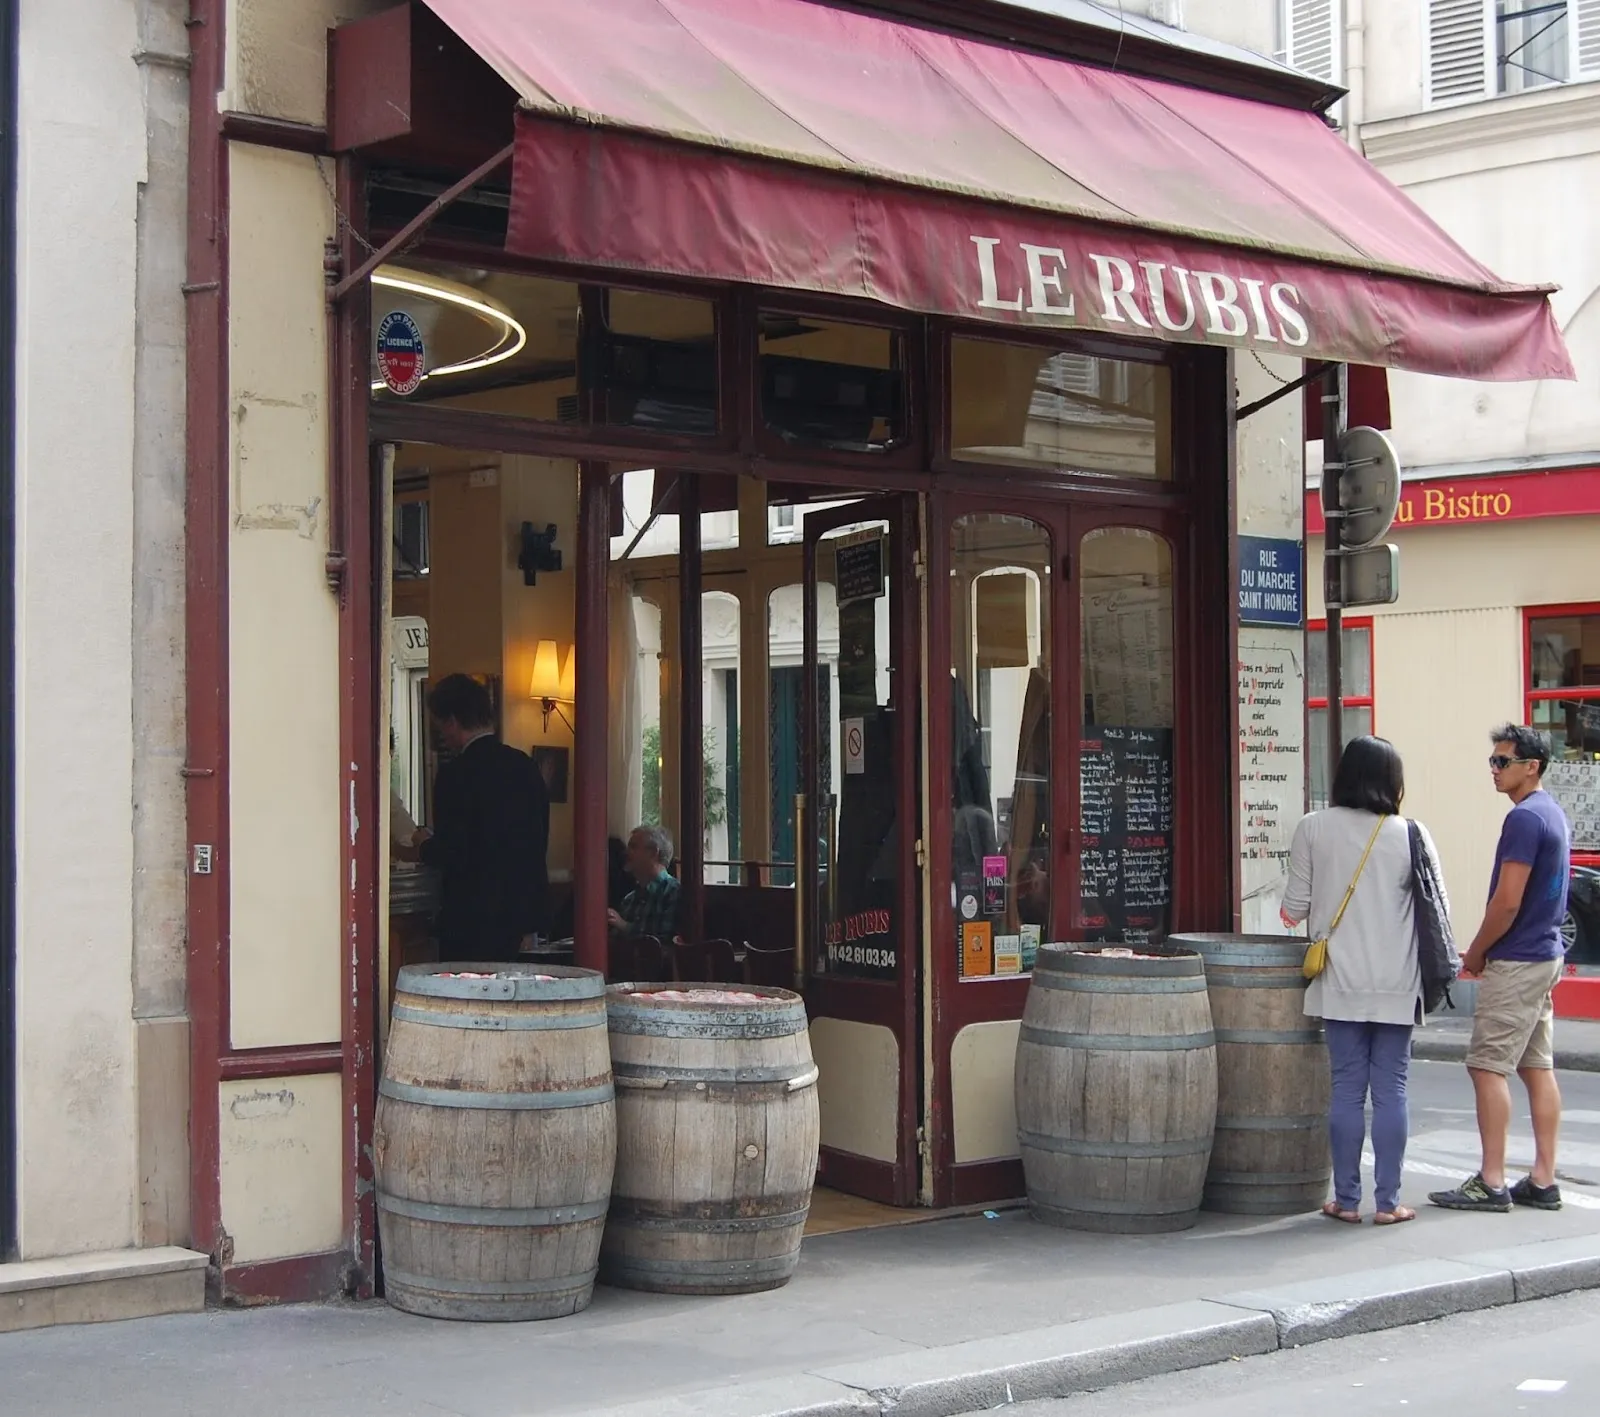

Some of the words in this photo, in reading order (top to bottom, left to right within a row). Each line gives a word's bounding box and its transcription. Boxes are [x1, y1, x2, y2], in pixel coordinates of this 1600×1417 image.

[970, 235, 1075, 316] LE
[1088, 252, 1309, 346] RUBIS
[378, 316, 394, 341] VILLE
[402, 316, 421, 343] PARIS
[386, 337, 414, 348] LICENCE
[396, 353, 424, 392] BOISSONS
[1393, 500, 1415, 522] u
[1423, 487, 1512, 520] Bistro
[1259, 549, 1278, 568] RUE
[1241, 569, 1255, 588] DU
[1257, 570, 1296, 591] MARCHÉ
[1239, 590, 1263, 609] SAINT
[1264, 592, 1298, 612] HONORÉ
